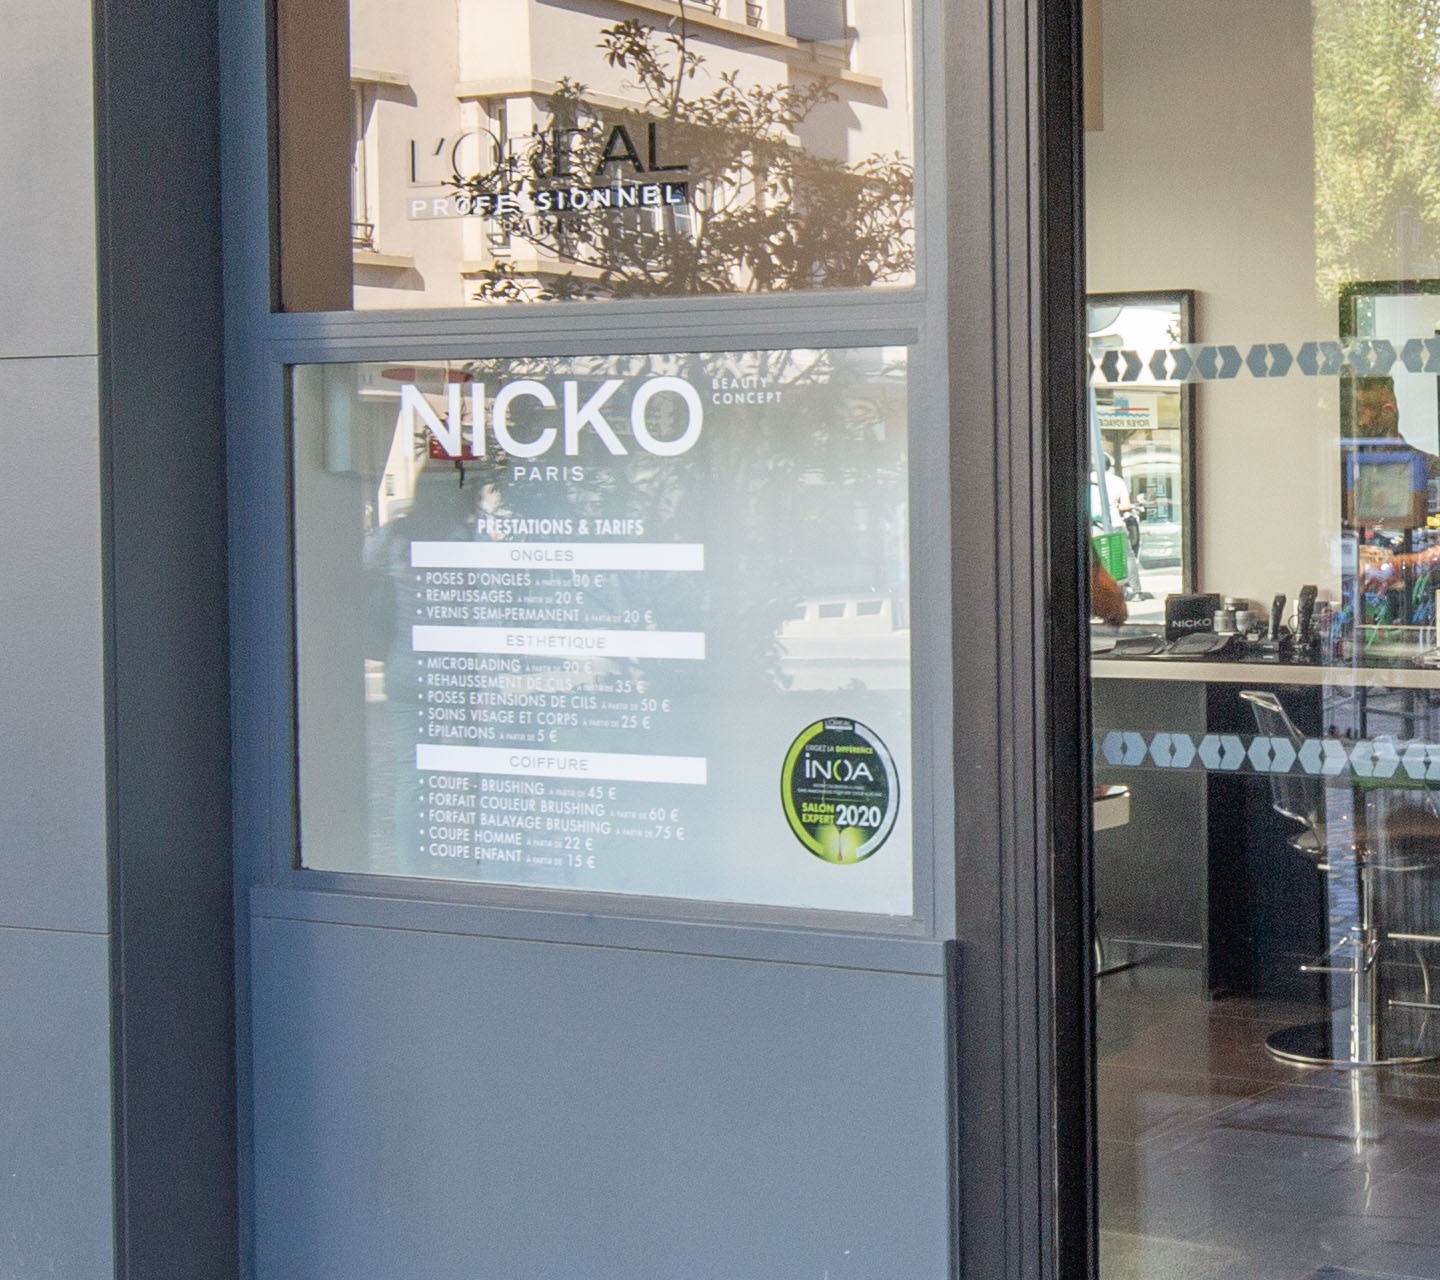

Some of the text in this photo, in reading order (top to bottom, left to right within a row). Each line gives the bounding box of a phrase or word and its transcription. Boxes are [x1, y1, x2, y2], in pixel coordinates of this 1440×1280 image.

[411, 184, 682, 218] PROFESIONNEL
[712, 378, 768, 391] BEAUTY
[712, 391, 782, 405] CONCEPT
[401, 376, 703, 458] NICKO
[514, 465, 585, 482] PARIS
[478, 519, 644, 536] PRESTATIONS & TARIFS
[510, 549, 574, 562] ONGLES
[426, 573, 464, 586] POSES
[468, 573, 531, 587] D'ONGLES
[594, 575, 603, 588] €
[426, 590, 512, 604] REMPLISSAGES
[555, 592, 571, 605] 20
[575, 592, 584, 605] €
[426, 607, 469, 620] VERNIS
[473, 607, 579, 622] SEMI-PERMANENT
[623, 611, 639, 624] 20
[644, 611, 654, 624] €
[1171, 618, 1212, 628] NICKO
[506, 632, 606, 650] ESTHÉTIQUE
[427, 657, 521, 672] MICROBLADING
[563, 661, 578, 674] 90
[584, 661, 592, 674] €
[427, 674, 524, 690] REHAUSSEMENT
[527, 677, 542, 690] DE
[546, 678, 573, 691] CILS
[616, 680, 632, 693] 35
[636, 680, 645, 694] €
[428, 691, 466, 705] POSES
[469, 692, 546, 708] EXTENSIONS
[551, 695, 566, 708] DE
[571, 696, 597, 710] CILS
[640, 699, 657, 712] 50
[662, 699, 671, 713] €
[428, 707, 466, 721] SOINS
[470, 709, 514, 723] VISAGE
[519, 711, 532, 724] ET
[536, 711, 578, 726] CORPS
[621, 715, 637, 728] 25
[642, 716, 651, 729] €
[428, 722, 495, 740] ÉPILATIONS
[537, 729, 545, 742] 5
[549, 729, 558, 743] €
[510, 756, 589, 770] COIFFURE
[428, 775, 470, 790] COUPE
[481, 778, 545, 796] BRUSHING
[587, 786, 604, 799] 45
[608, 786, 617, 800] €
[428, 792, 476, 808] FORFAIT
[480, 796, 536, 813] COULEUR
[540, 799, 605, 817] BRUSHING
[648, 808, 665, 821] 60
[670, 808, 679, 822] €
[801, 803, 834, 813] SALON
[836, 804, 881, 827] 2020
[428, 809, 476, 825] FORFAIT
[480, 812, 542, 830] BALAYAGE
[546, 816, 612, 835] BRUSHING
[654, 825, 671, 839] 75
[676, 826, 685, 840] €
[802, 814, 835, 825] EXPERT
[428, 826, 470, 842] COUPE
[474, 829, 522, 845] HOMME
[564, 836, 580, 850] 22
[584, 837, 593, 851] €
[428, 843, 470, 859] COUPE
[474, 846, 522, 863] ENFANT
[567, 854, 583, 867] 15
[587, 854, 595, 868] €
